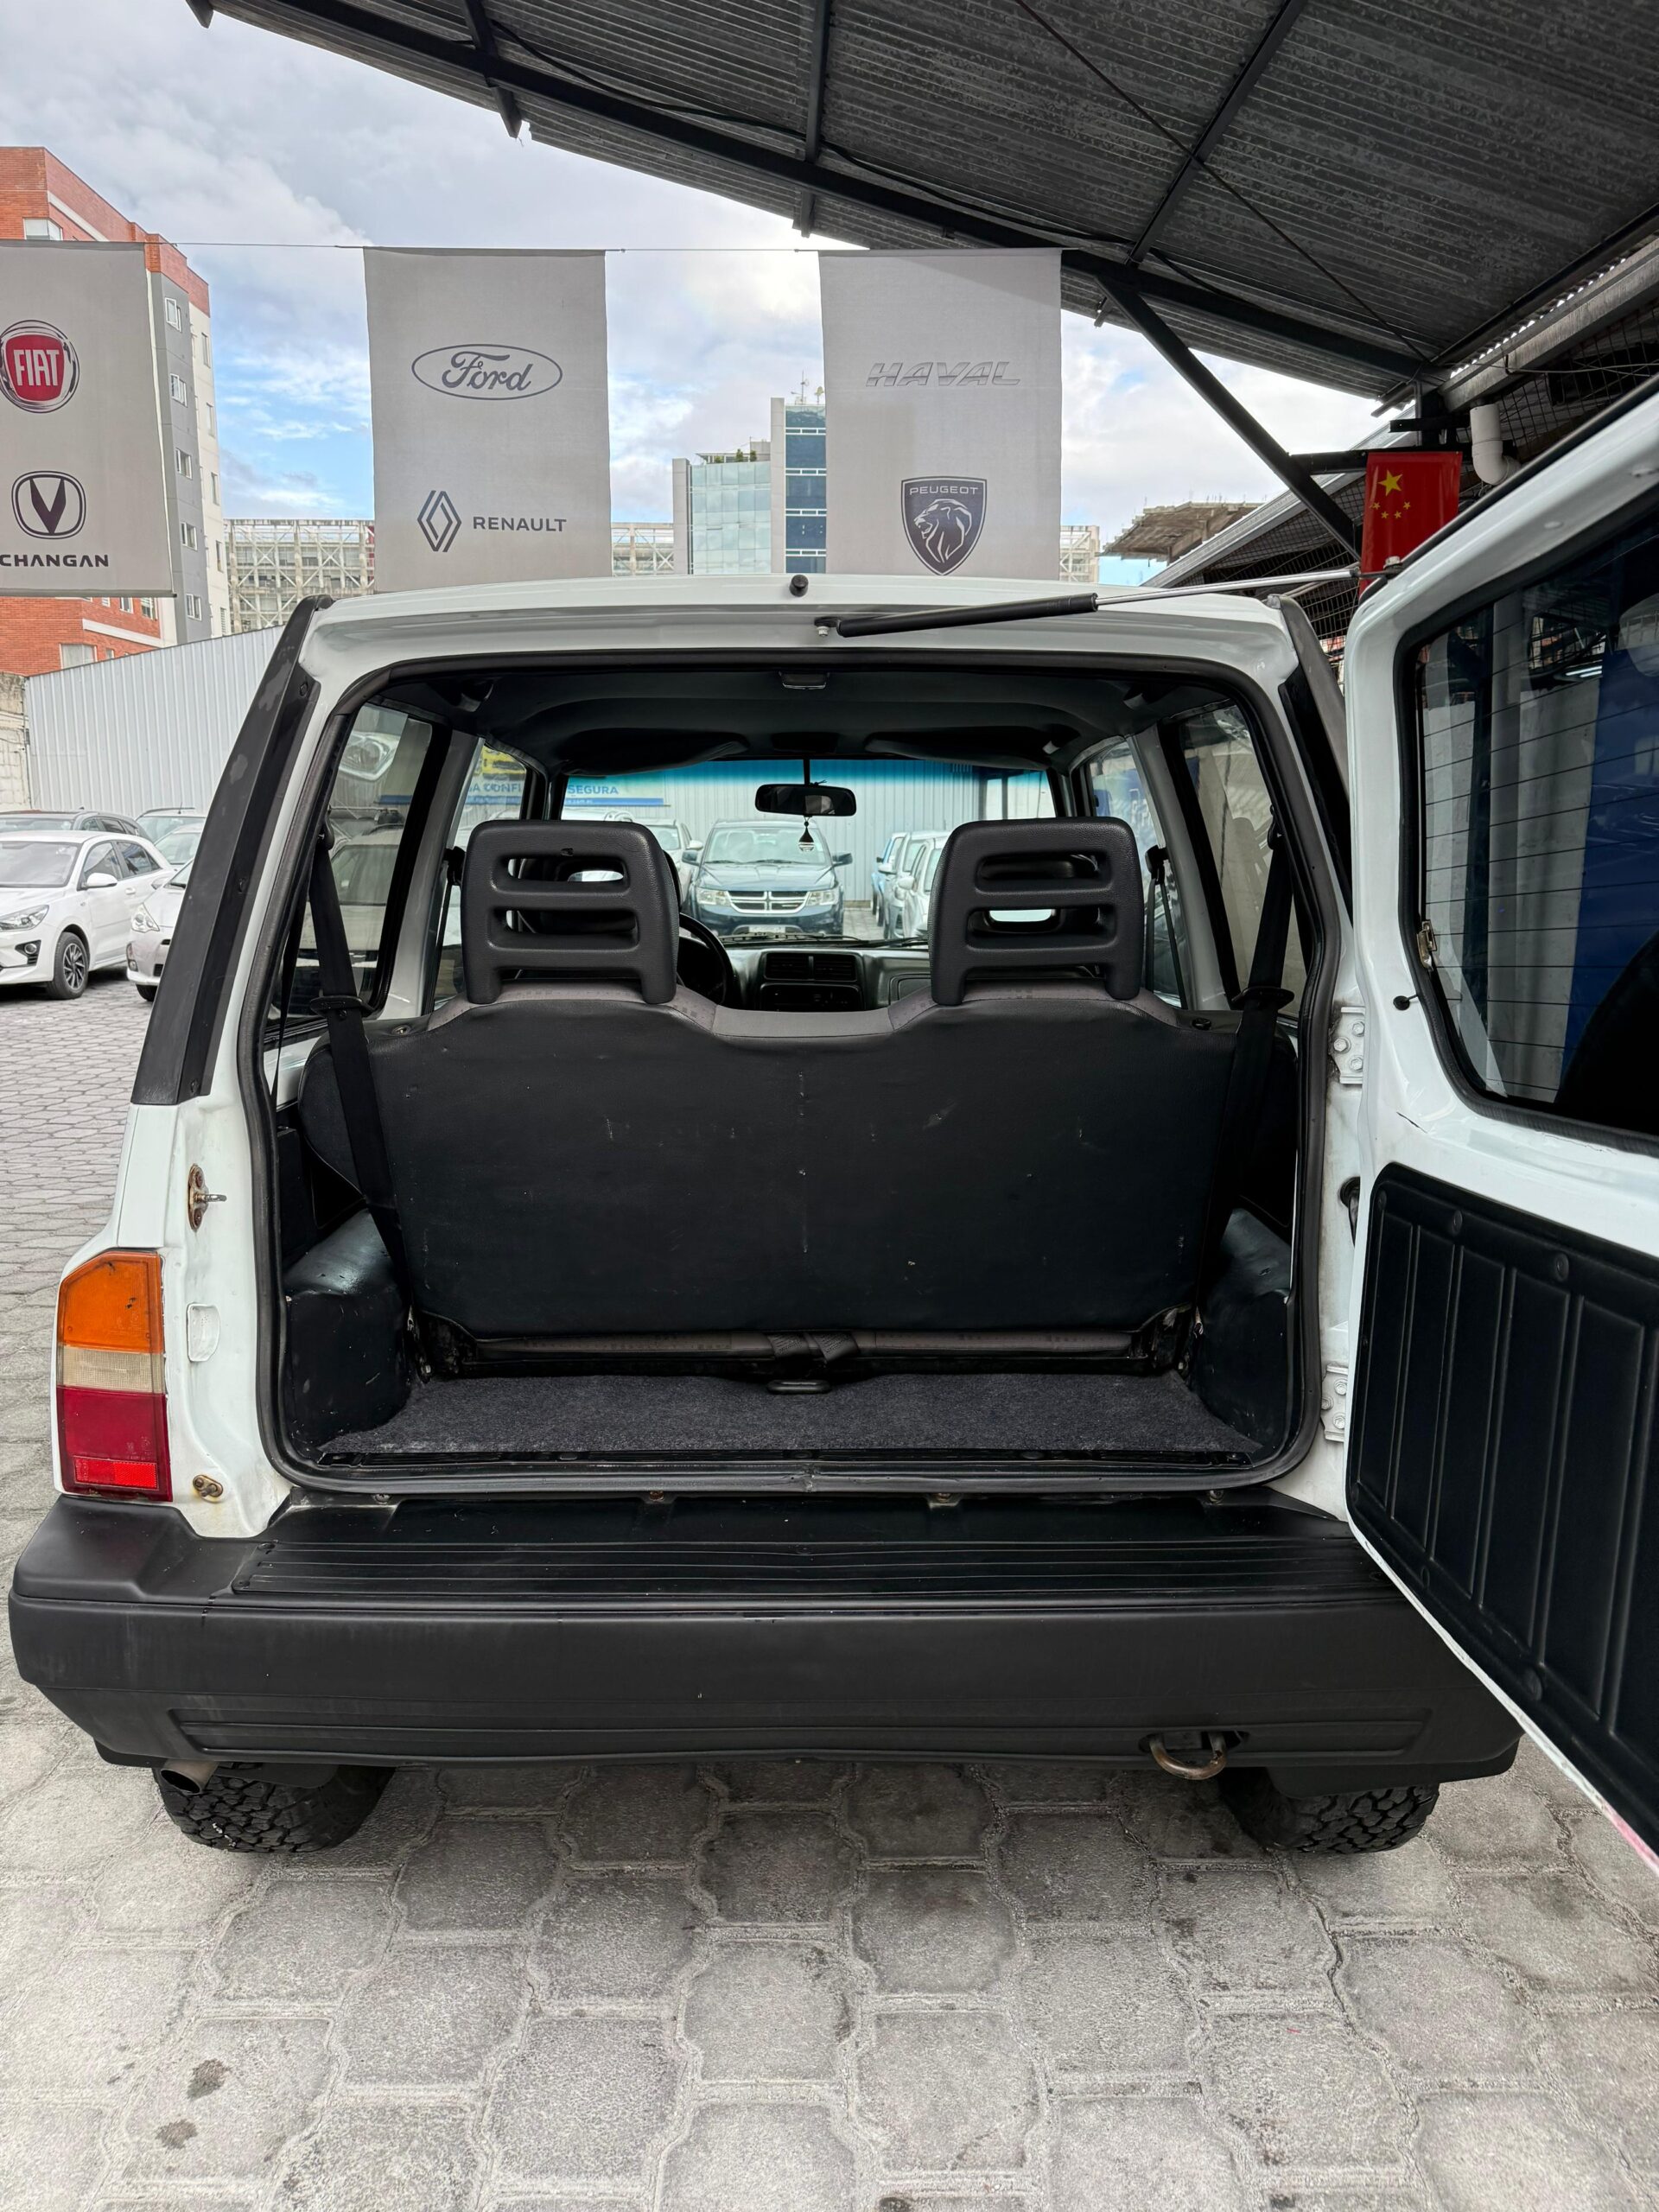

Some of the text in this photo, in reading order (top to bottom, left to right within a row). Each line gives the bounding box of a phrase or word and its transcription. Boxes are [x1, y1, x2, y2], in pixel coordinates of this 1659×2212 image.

[13, 349, 60, 386] FIAT
[442, 351, 534, 391] Ford
[865, 361, 1020, 387] HAVAL
[909, 486, 979, 496] PEUGEOT
[473, 516, 567, 532] RENAULT
[0, 554, 109, 568] CHANGAN
[567, 785, 619, 795] SEGURA
